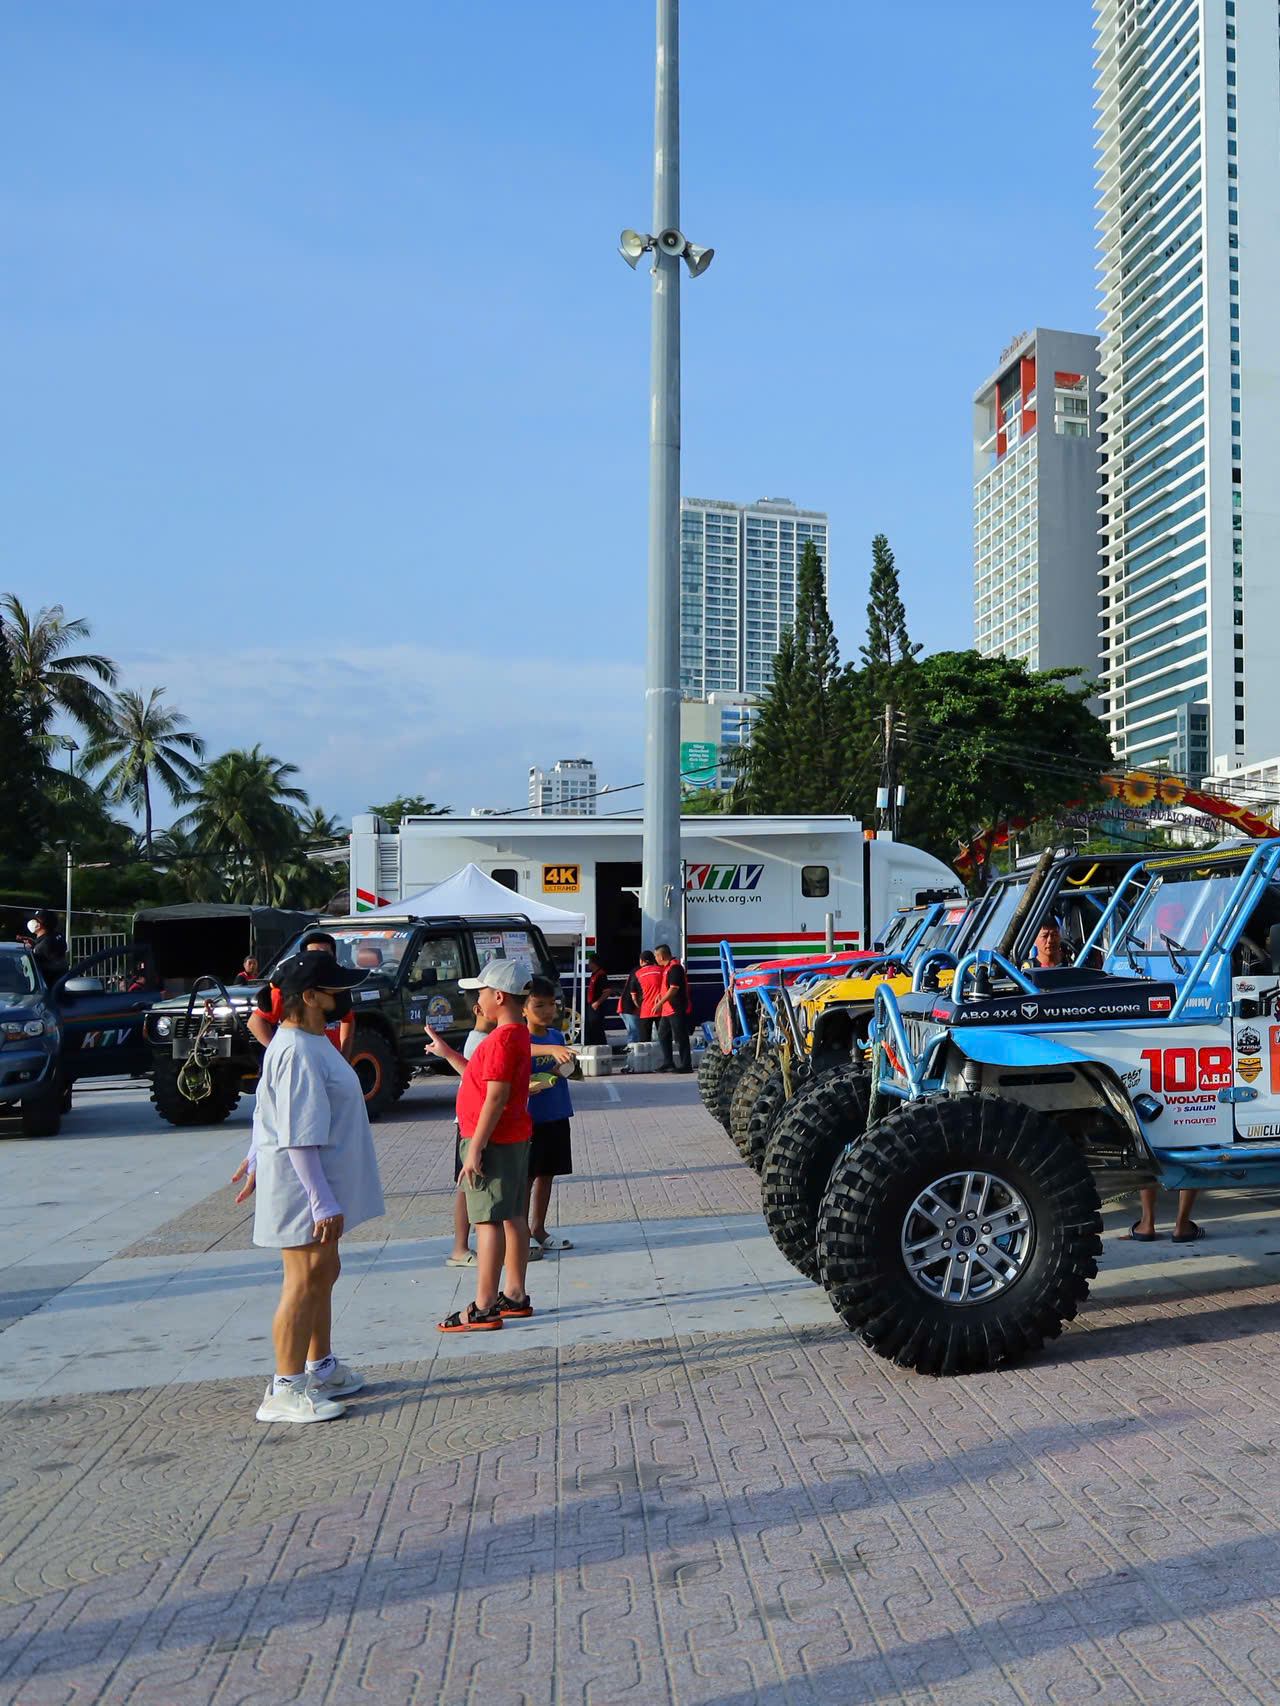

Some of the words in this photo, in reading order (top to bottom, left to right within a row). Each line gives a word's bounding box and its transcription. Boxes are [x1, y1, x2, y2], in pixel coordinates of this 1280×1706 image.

[546, 868, 576, 883] 4K
[686, 864, 764, 889] KTV
[686, 894, 762, 905] ww.ktv.org.vn
[410, 1010, 421, 1020] 214
[960, 1010, 989, 1020] A.B.O
[993, 1009, 1018, 1018] 4X4
[1043, 1008, 1060, 1017] VU
[1062, 1006, 1096, 1016] NGOC
[1098, 1004, 1141, 1014] CUONG
[81, 1027, 132, 1049] KTV
[1120, 1068, 1143, 1080] FAST
[1140, 1046, 1233, 1093] 108
[1164, 1093, 1217, 1105] WOLVER
[1184, 1104, 1216, 1112] SAILUN
